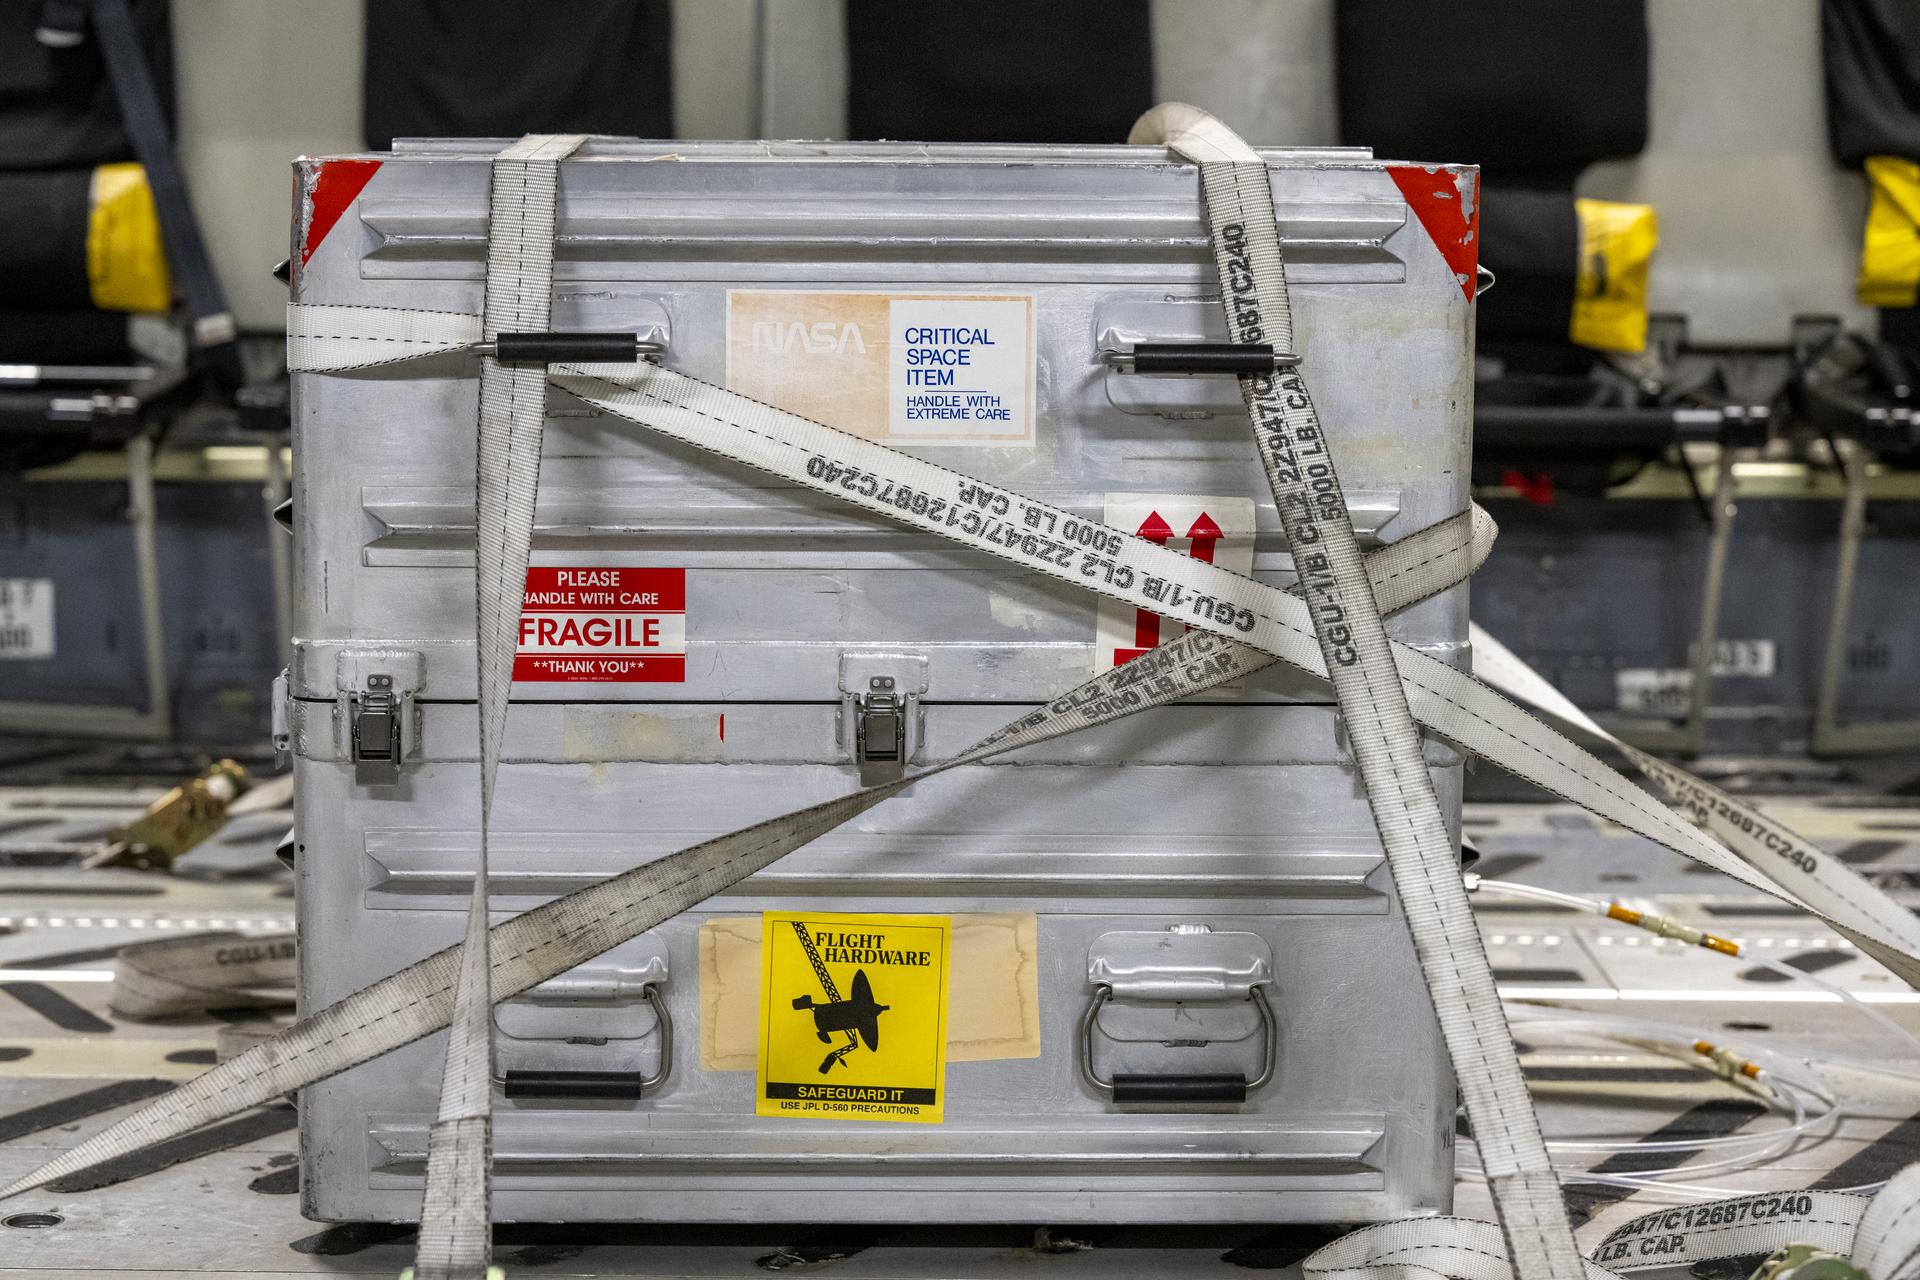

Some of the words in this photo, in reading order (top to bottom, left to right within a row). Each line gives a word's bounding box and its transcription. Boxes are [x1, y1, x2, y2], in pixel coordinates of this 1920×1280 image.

[752, 322, 866, 354] NASA
[905, 327, 995, 345] CRITICAL
[906, 348, 971, 366] SPACE
[906, 369, 954, 386] ITEM
[906, 396, 961, 407] HANDLE
[966, 395, 1000, 407] WITH
[906, 408, 970, 420] EXTREME
[975, 408, 1011, 421] CARE
[1296, 418, 1322, 456] LB.
[957, 480, 1010, 516] CAP.
[1307, 463, 1342, 522] 5000
[1019, 502, 1058, 534] LB.
[1287, 492, 1320, 545] CL2
[1062, 519, 1124, 557] 5000
[557, 571, 620, 587] PLEASE
[1080, 554, 1135, 590] CL2
[579, 592, 615, 605] WITH
[619, 592, 659, 605] CARE
[1142, 575, 1256, 632] CGU-1/B
[1305, 552, 1358, 667] CGU-1/B
[518, 618, 660, 647] FRAGILE
[1082, 691, 1143, 720] 5000
[815, 932, 885, 949] FLIGHT
[824, 948, 931, 966] HARDWARE
[798, 1086, 888, 1101] SAFEGUARD
[891, 1090, 905, 1101] IT
[781, 1102, 800, 1110] USE
[802, 1102, 820, 1111] JPL
[822, 1103, 849, 1112] D-560
[851, 1104, 920, 1115] PRECAUTIONS
[1640, 1235, 1686, 1256] CAP.
